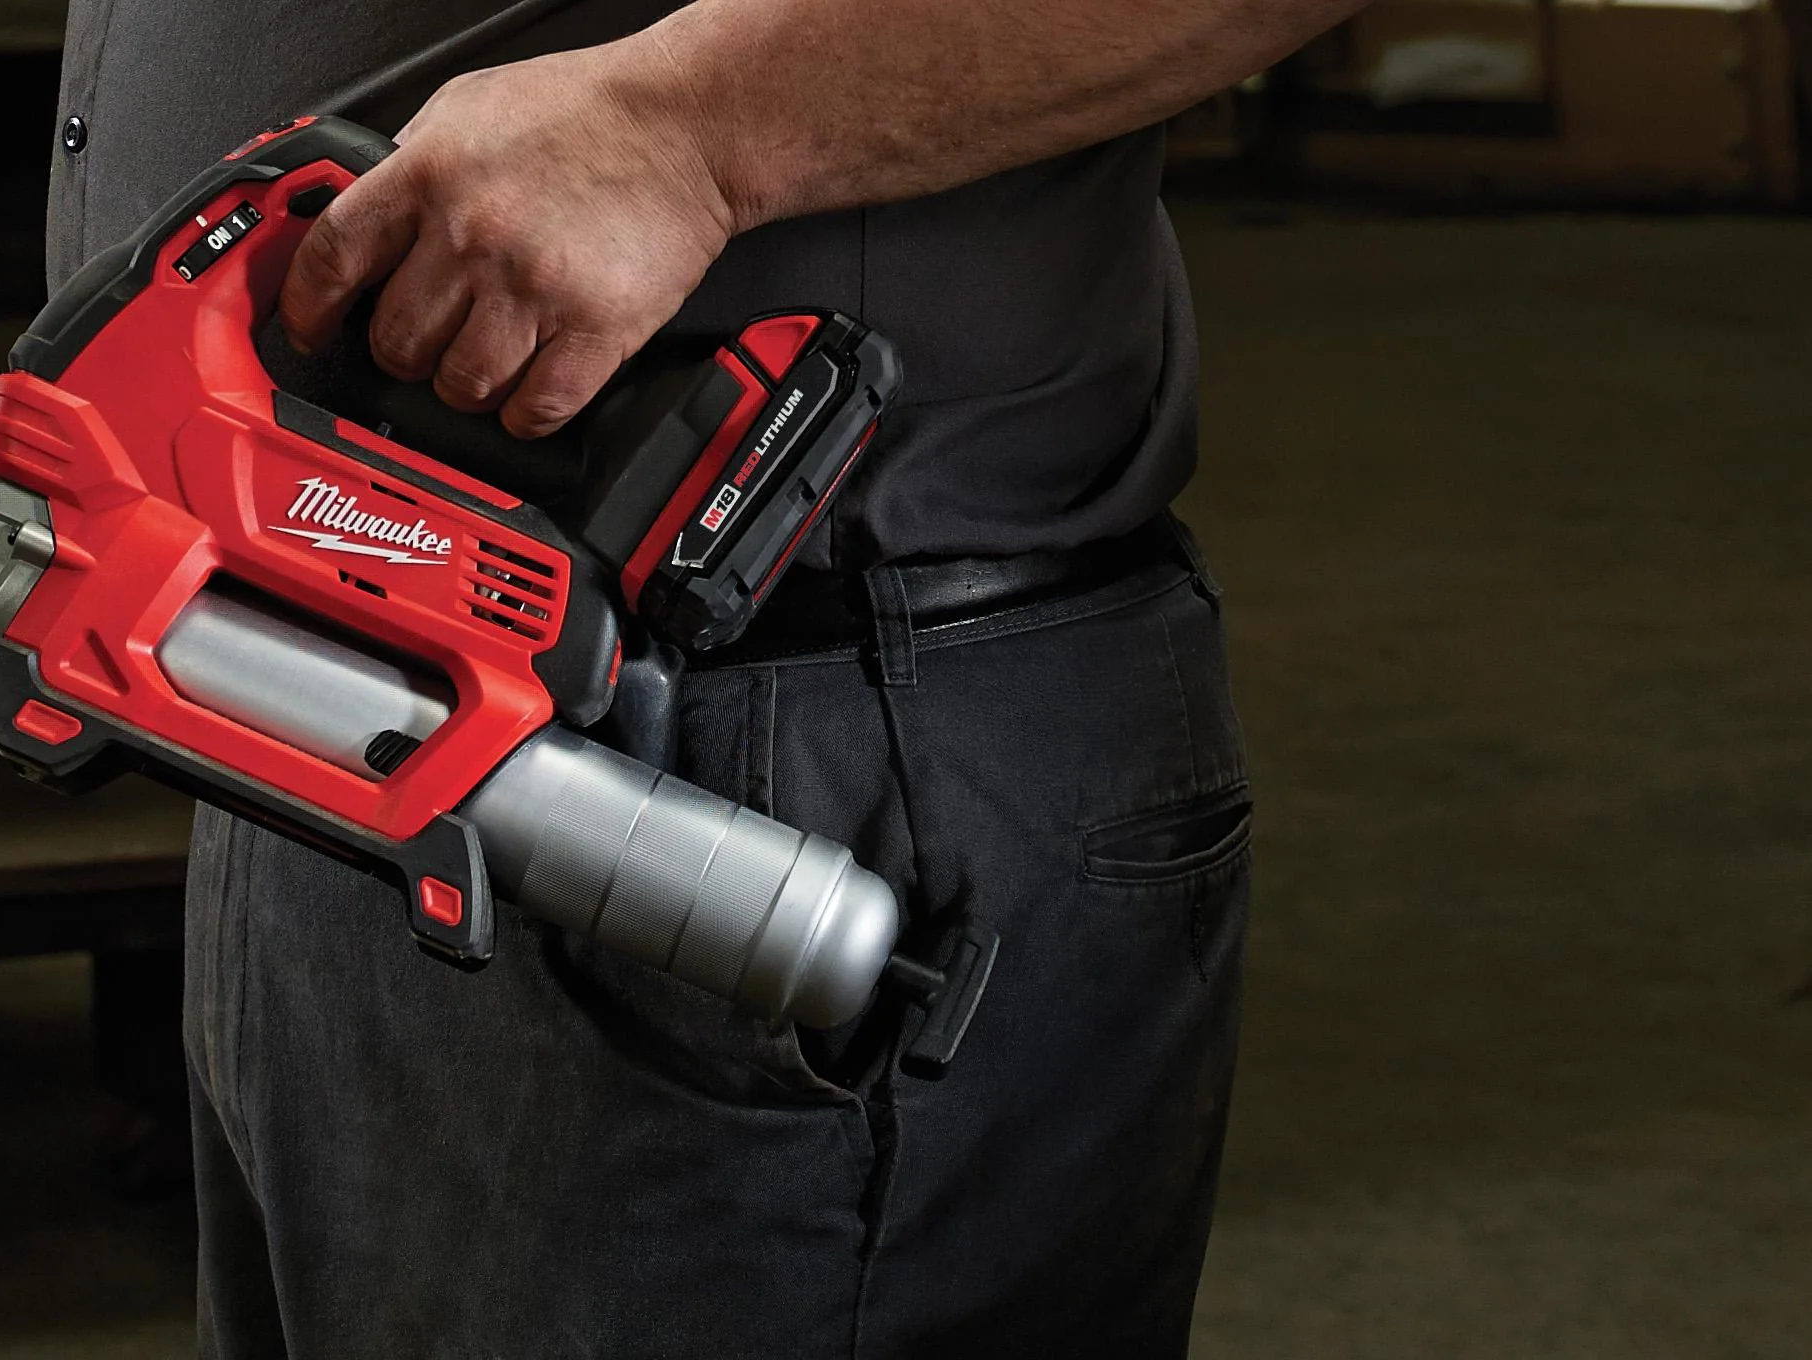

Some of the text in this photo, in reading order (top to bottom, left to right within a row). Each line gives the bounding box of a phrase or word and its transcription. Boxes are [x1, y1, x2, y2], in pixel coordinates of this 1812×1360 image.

[207, 226, 233, 250] ON
[232, 215, 246, 230] 1
[703, 388, 804, 530] M18 REDLITHIUM
[288, 477, 452, 555] Milwaukee
